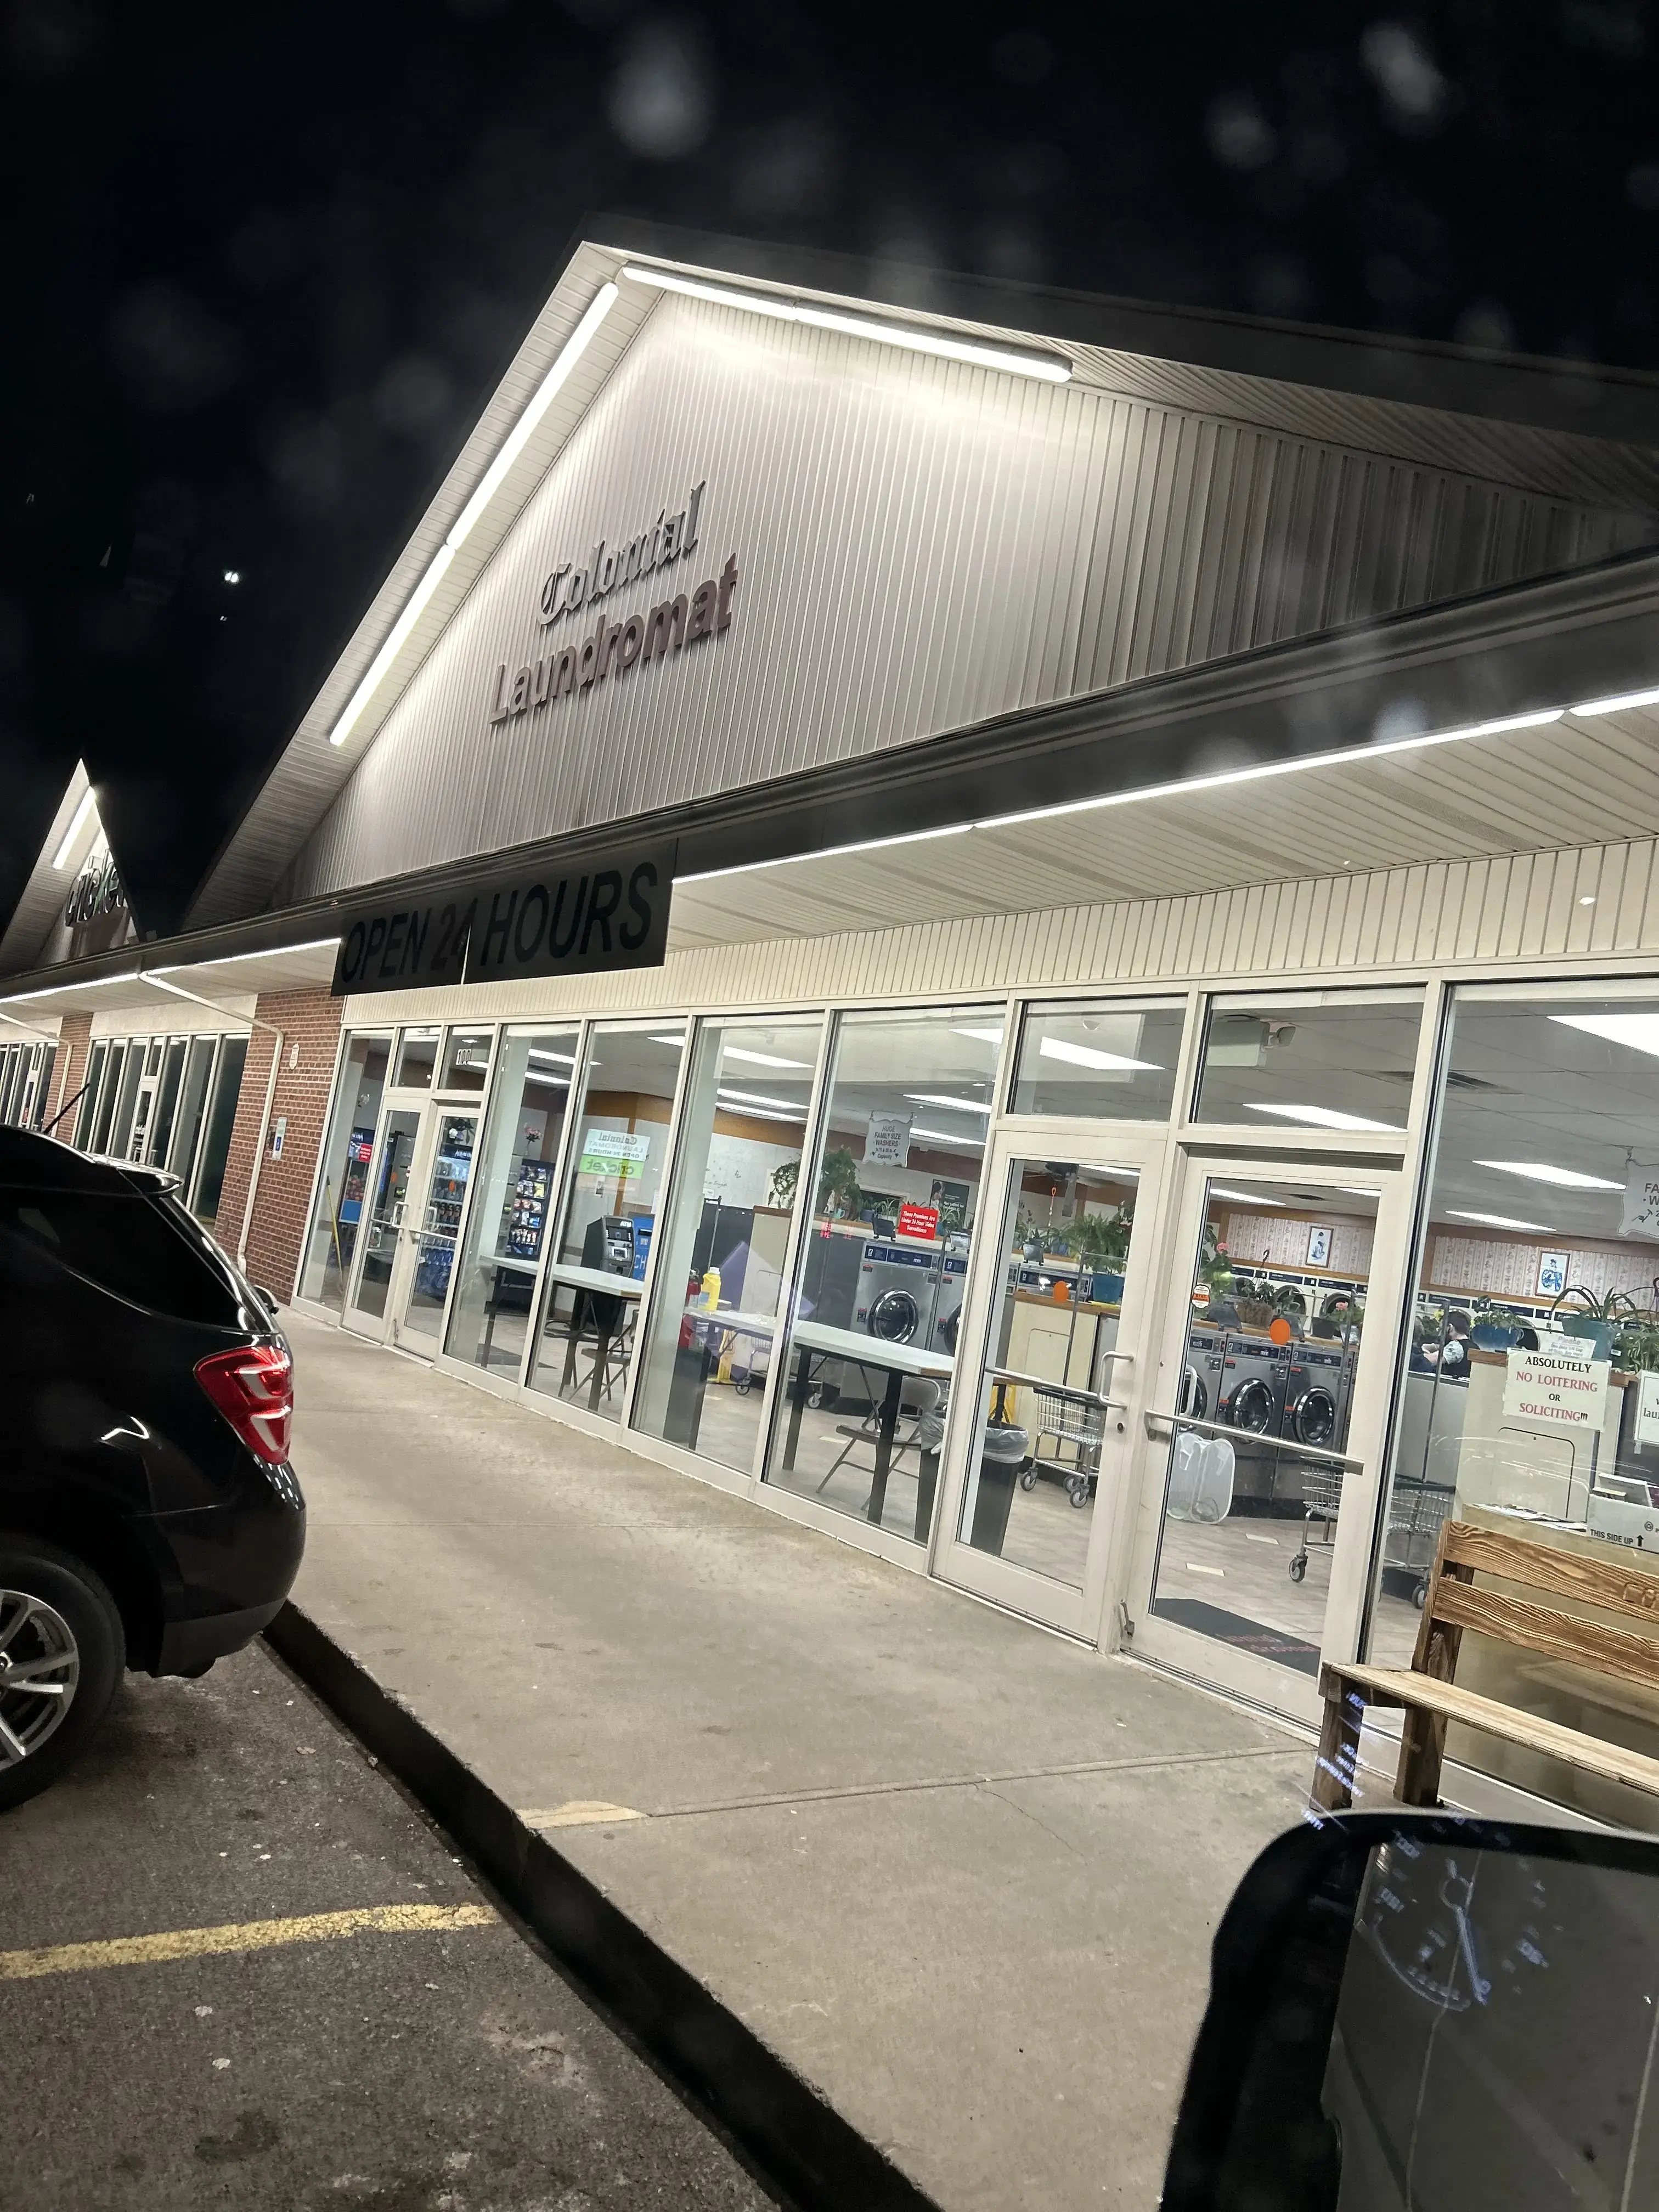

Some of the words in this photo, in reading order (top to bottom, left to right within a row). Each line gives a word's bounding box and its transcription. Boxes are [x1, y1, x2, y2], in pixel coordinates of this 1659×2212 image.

[536, 479, 706, 625] Colonial
[490, 552, 738, 724] Laundromat
[341, 908, 431, 983] OPEN
[431, 898, 478, 971] 24
[480, 861, 658, 966] HOURS
[1645, 1183, 1659, 1194] FA
[634, 1255, 647, 1271] CH
[1525, 1356, 1592, 1373] ABSOLUTELY
[1516, 1372, 1533, 1382] NO
[1537, 1374, 1598, 1392] LOITERING
[1643, 1407, 1659, 1419] lau
[1590, 1528, 1605, 1539] THIS
[1606, 1532, 1622, 1543] SIDE
